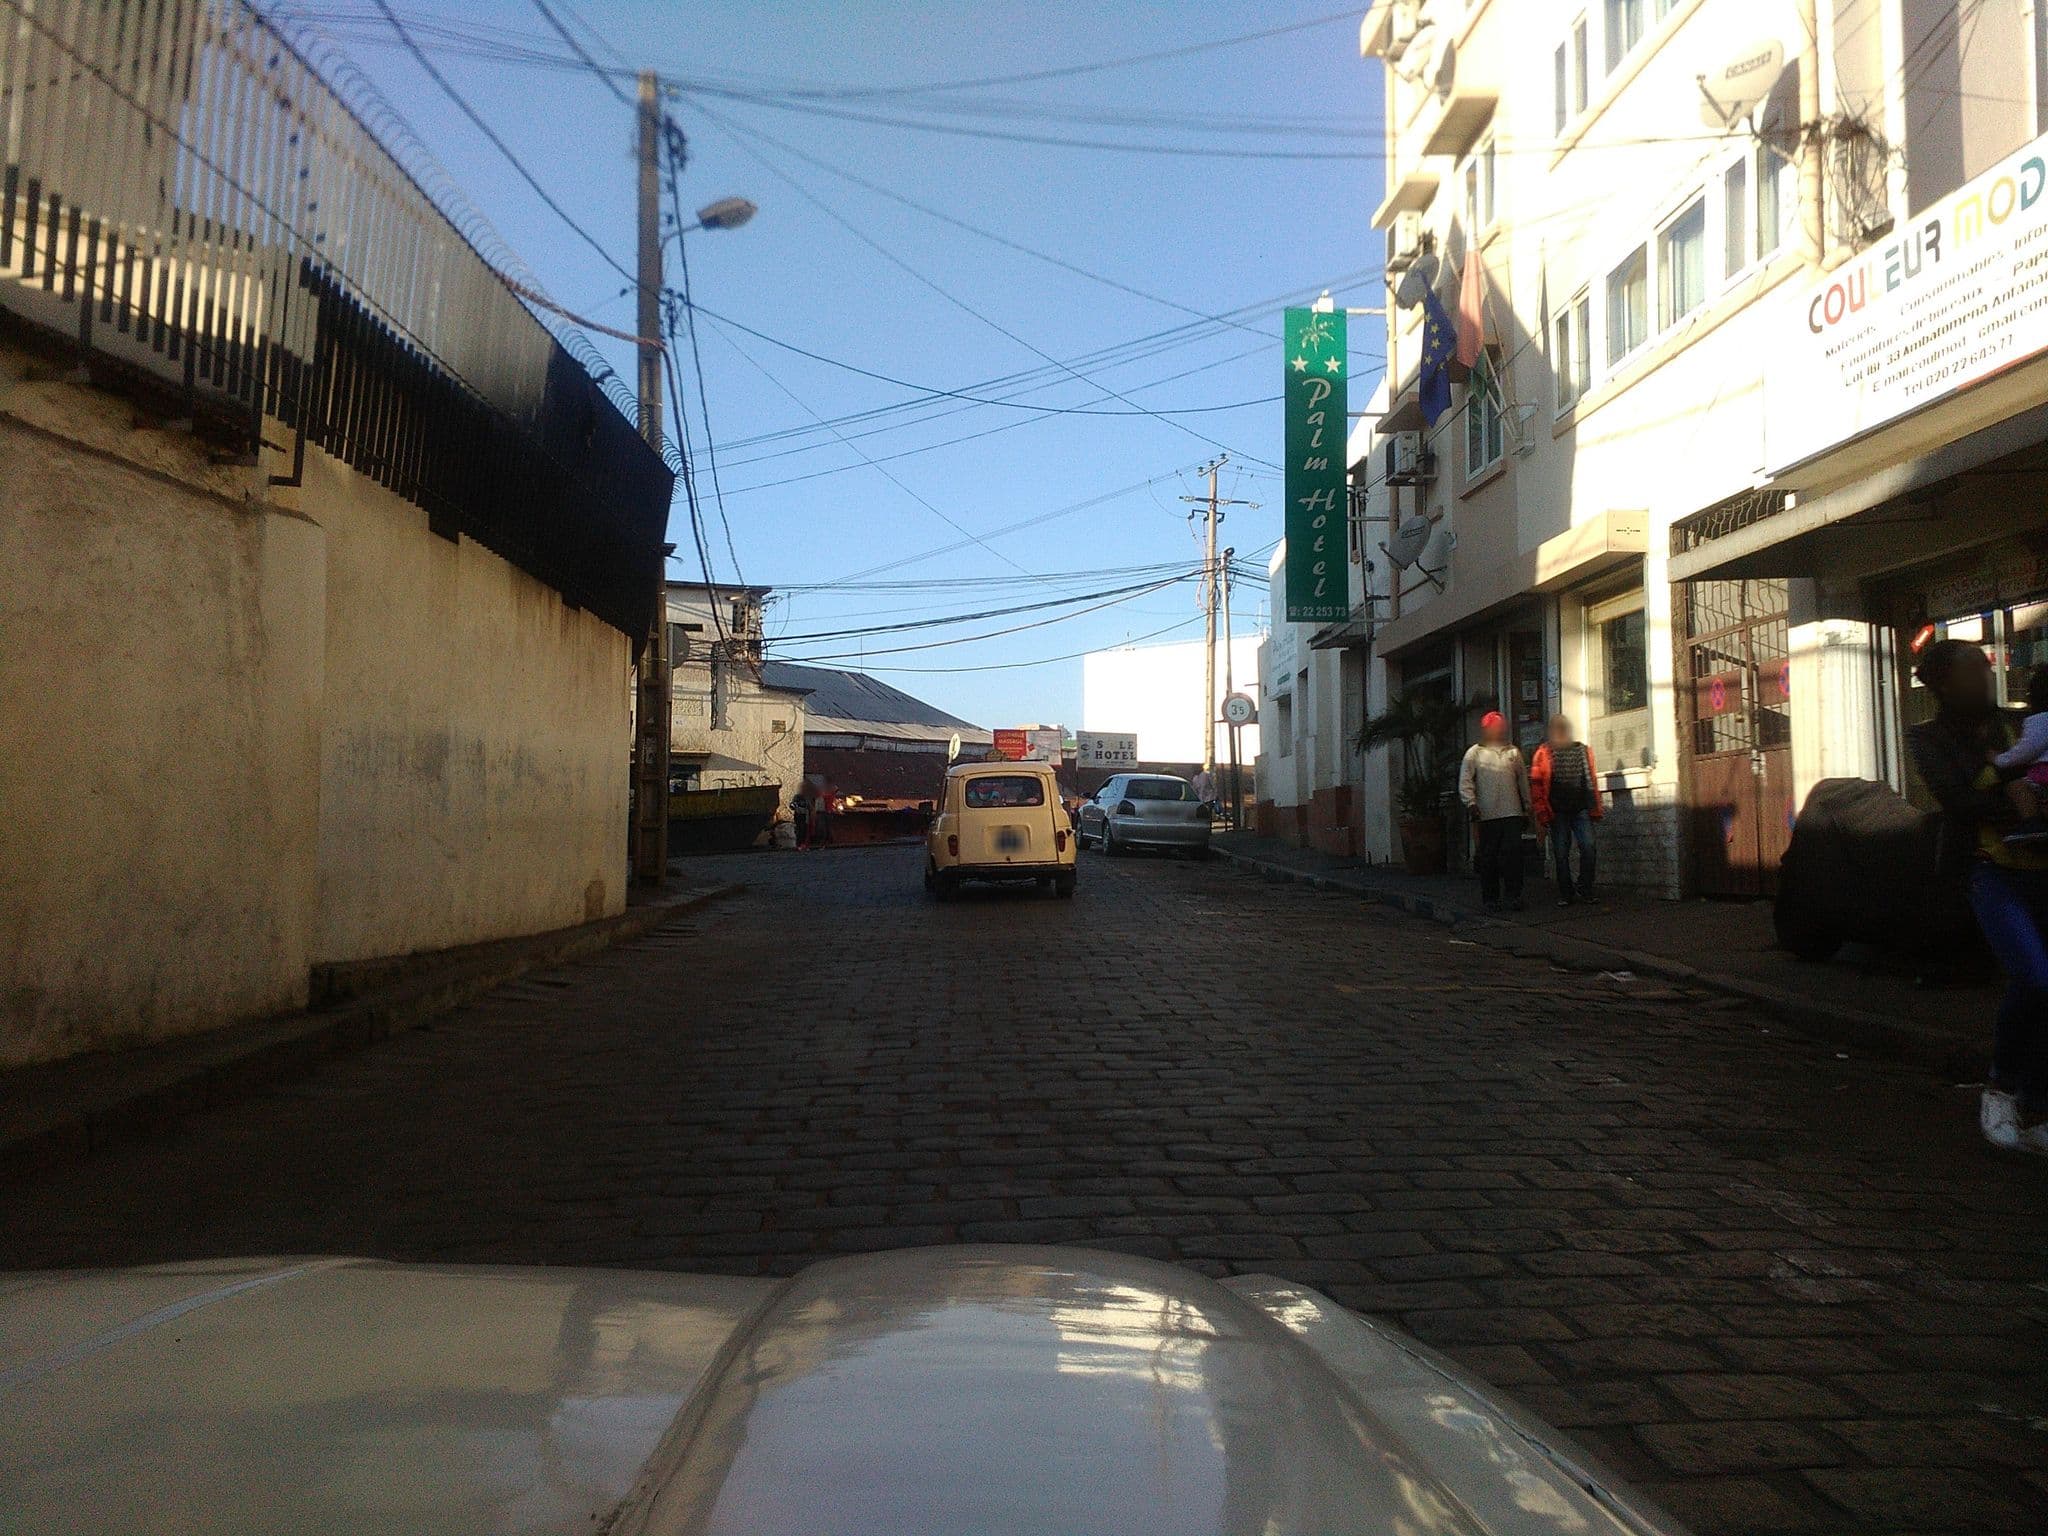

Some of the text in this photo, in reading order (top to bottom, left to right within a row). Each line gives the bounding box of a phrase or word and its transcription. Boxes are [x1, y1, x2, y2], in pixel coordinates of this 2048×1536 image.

[1809, 156, 2047, 334] COULEUR MOD
[1298, 377, 1336, 598] Palm Hotel
[1095, 750, 1137, 760] HOTEL
